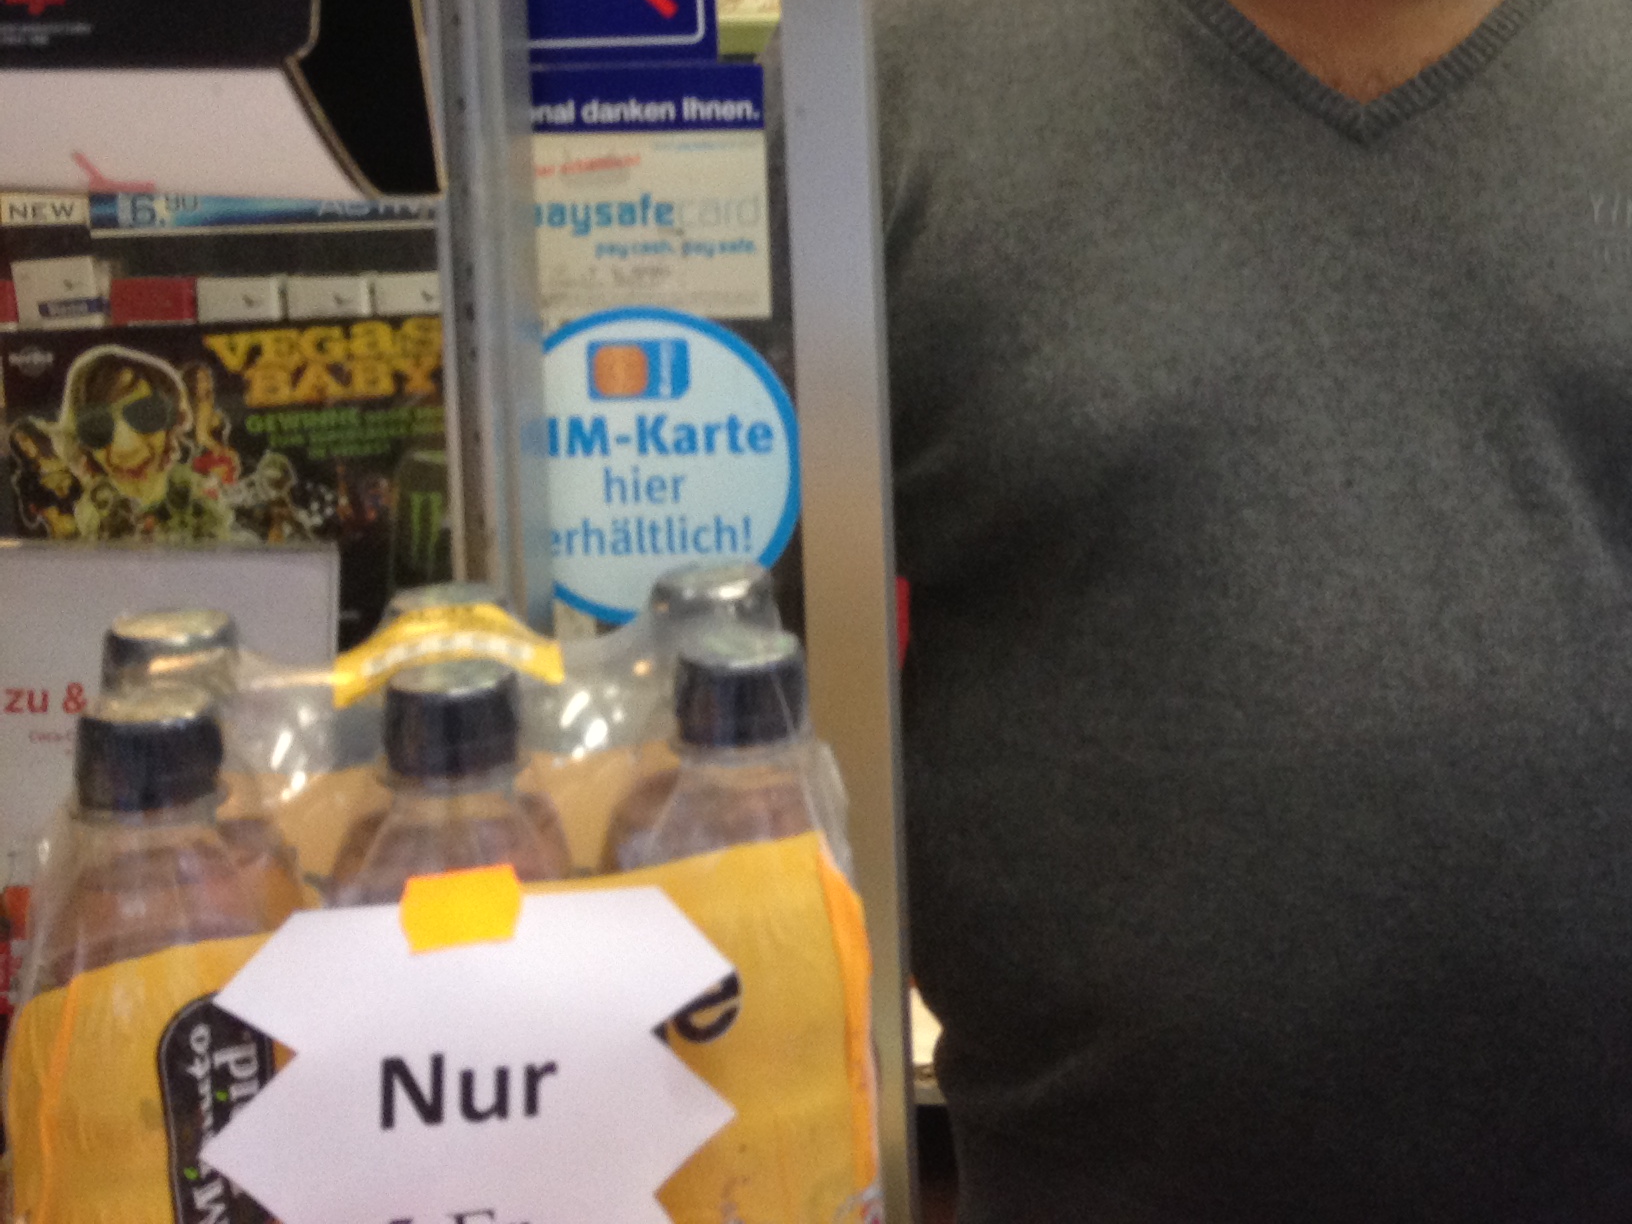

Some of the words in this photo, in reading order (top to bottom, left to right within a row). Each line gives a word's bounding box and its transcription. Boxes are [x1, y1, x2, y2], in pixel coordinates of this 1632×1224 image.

[580, 96, 677, 126] danken
[8, 200, 75, 222] NEW
[545, 413, 775, 458] IM-Karte
[602, 465, 687, 505] hier
[3, 685, 50, 715] zu
[380, 1052, 559, 1132] Nur
